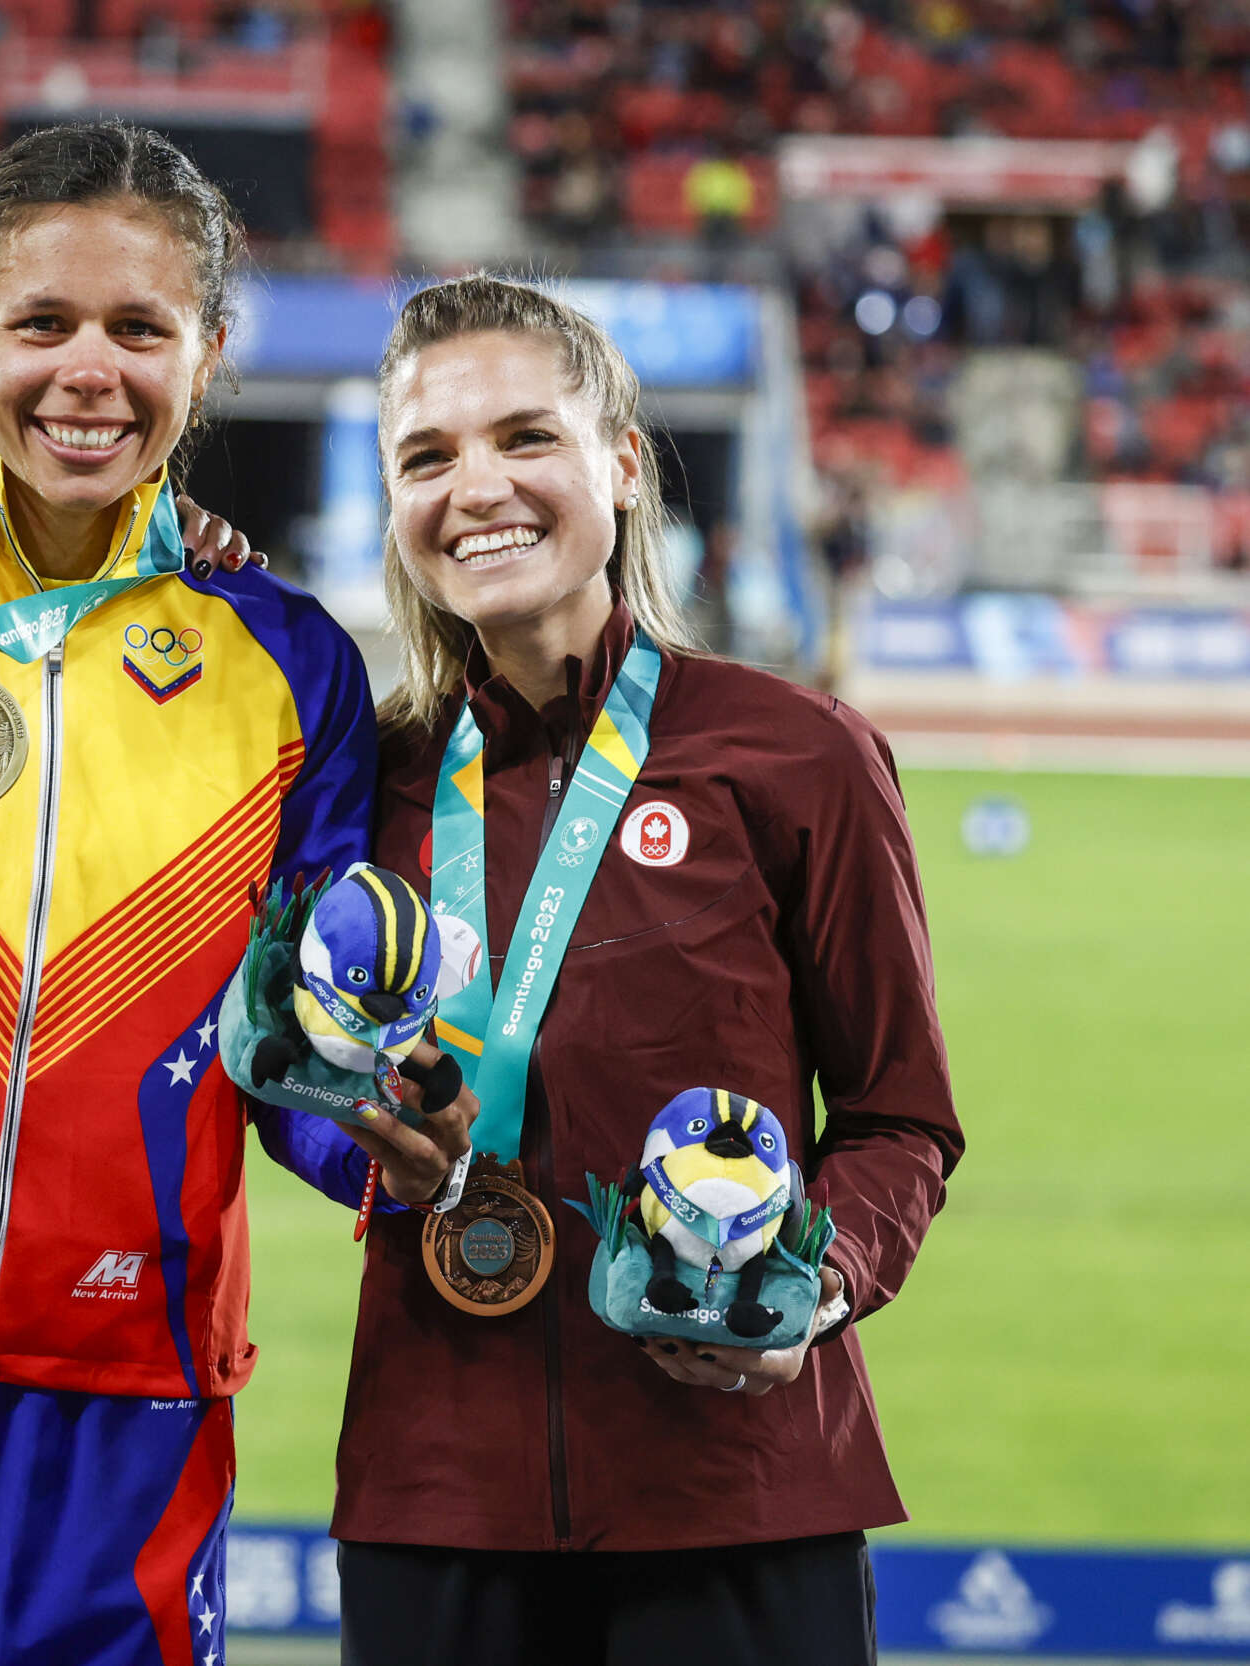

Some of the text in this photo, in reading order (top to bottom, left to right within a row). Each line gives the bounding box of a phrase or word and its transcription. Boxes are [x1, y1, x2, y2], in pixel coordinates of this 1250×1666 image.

[39, 604, 69, 632] 2023
[502, 885, 565, 1037] Santiago 2023
[325, 999, 365, 1032] 2023
[282, 1077, 354, 1107] Santiago
[664, 1189, 700, 1223] 2023
[741, 1205, 774, 1226] Santiago
[468, 1232, 508, 1242] Santiago
[468, 1245, 508, 1260] 2023
[71, 1288, 139, 1300] New Arrival
[150, 1400, 175, 1410] New
